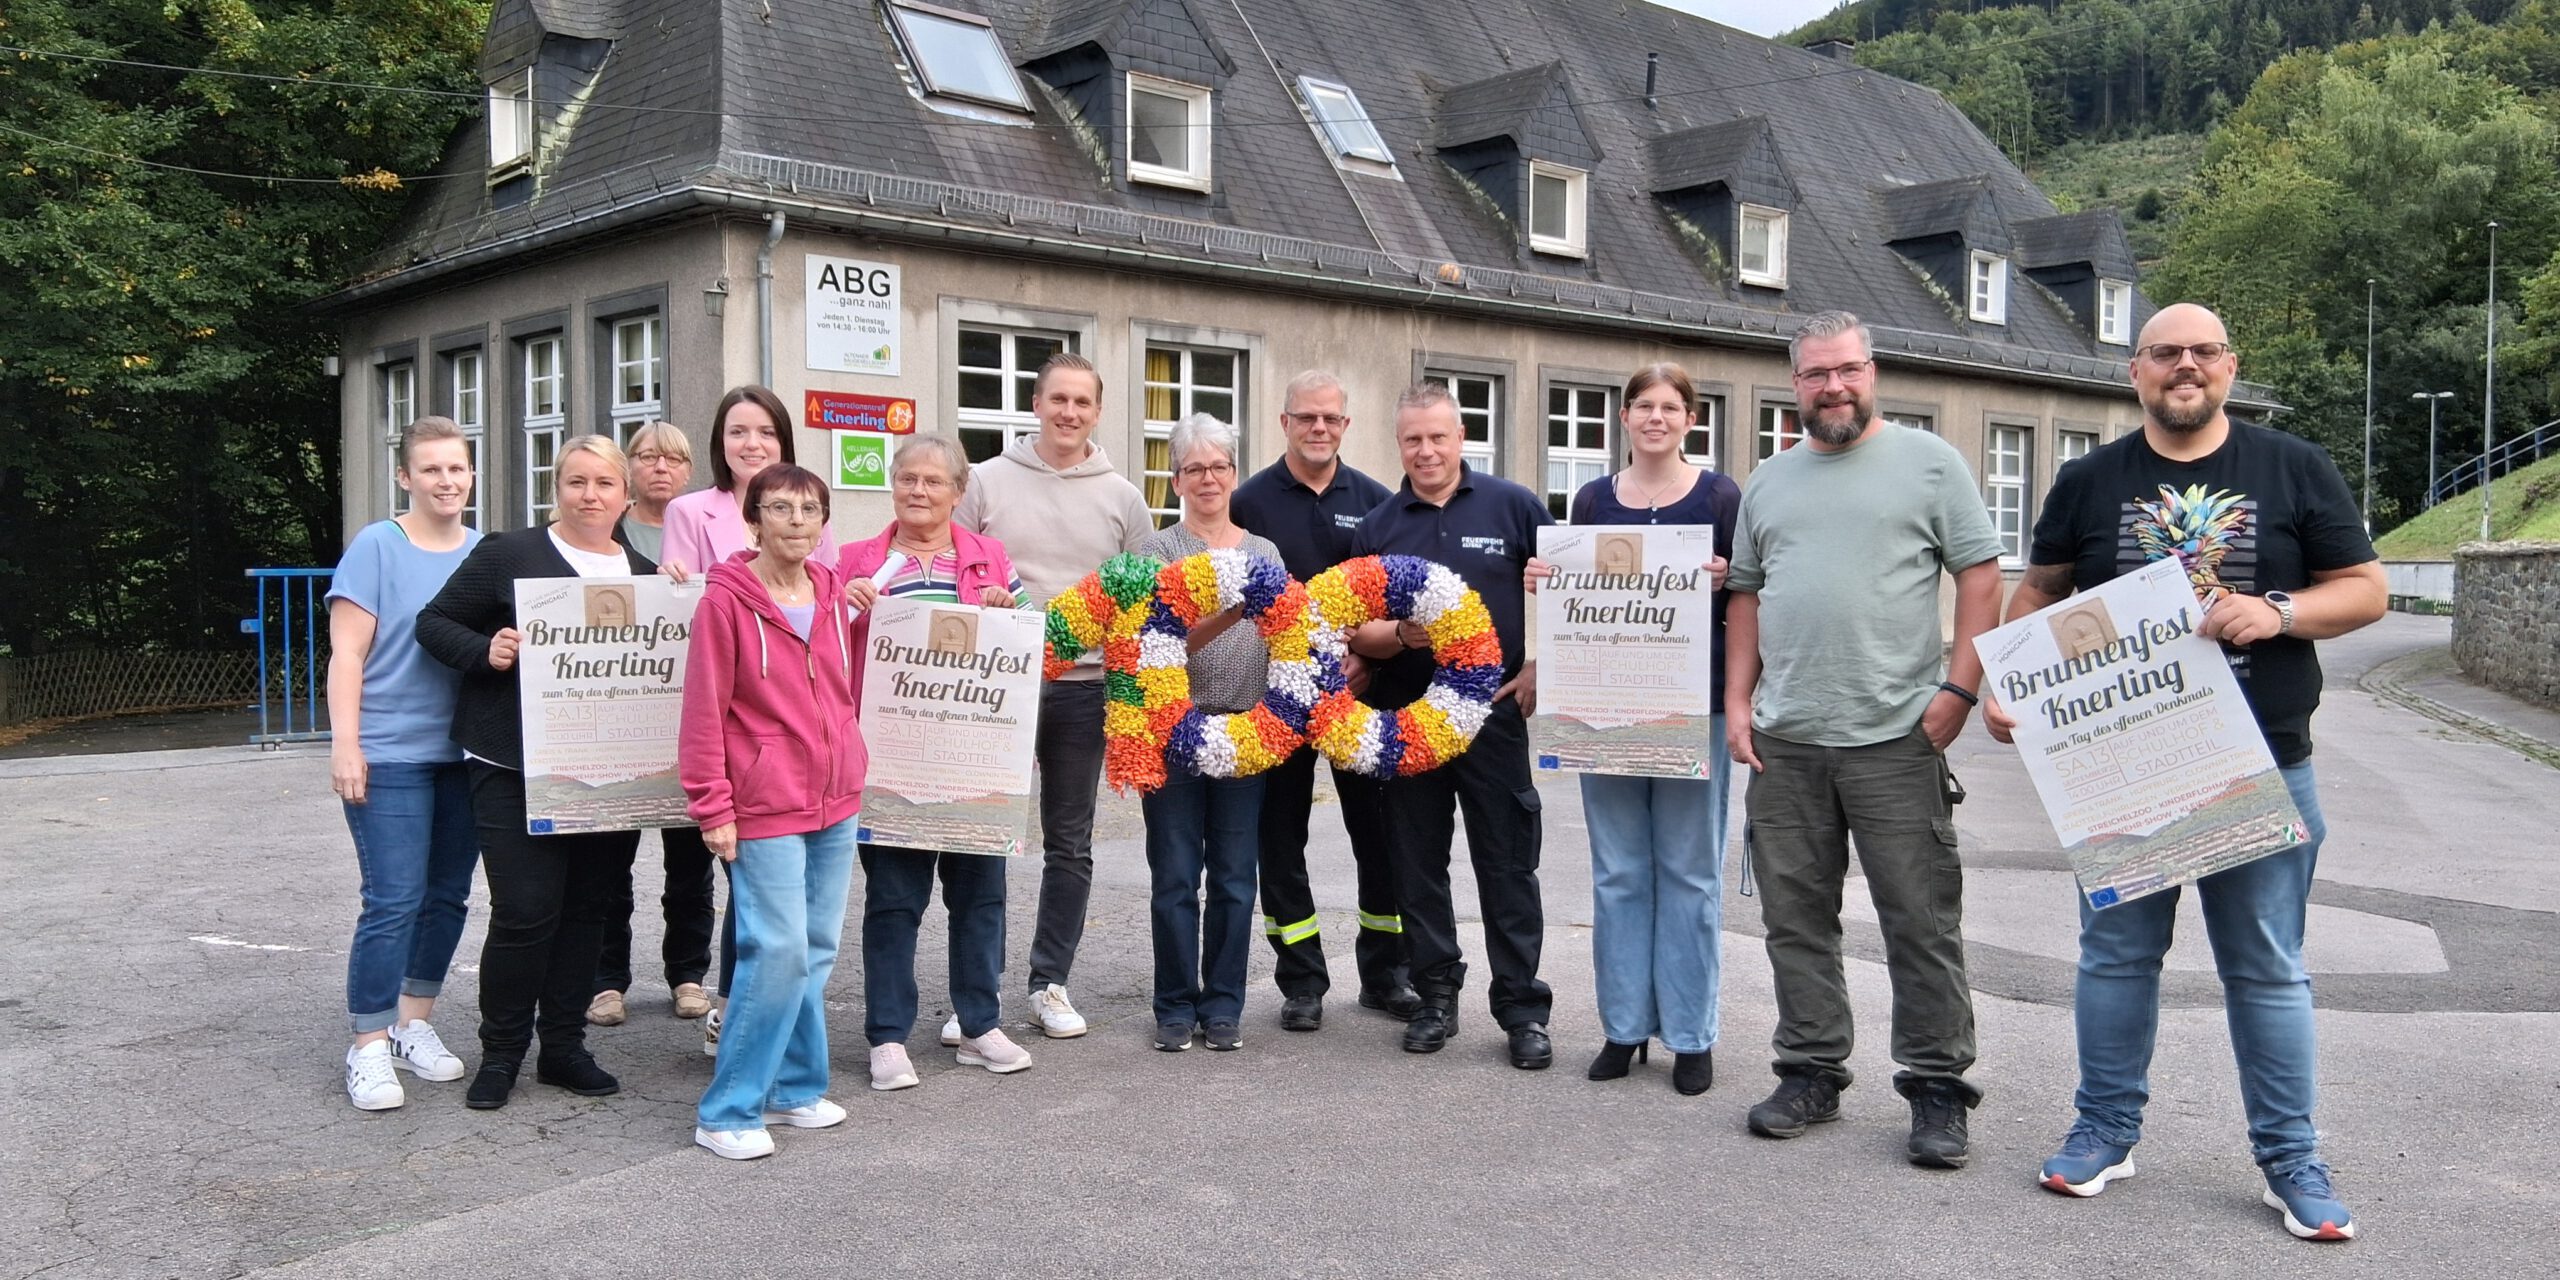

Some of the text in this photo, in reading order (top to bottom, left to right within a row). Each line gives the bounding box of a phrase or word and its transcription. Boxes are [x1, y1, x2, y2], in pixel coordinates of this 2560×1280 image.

[817, 263, 890, 297] ABG
[868, 299, 891, 310] nah!
[822, 312, 844, 321] Jeden
[854, 316, 885, 327] Dienstag
[823, 409, 886, 430] Knerling
[1334, 513, 1363, 523] FEUERW
[1461, 537, 1504, 545] FEUERWEHR
[1545, 564, 1700, 599] Brunnenfest
[1563, 597, 1676, 633] Knerling
[1553, 632, 1690, 644] zum Tag des offenen Denkmals
[1998, 631, 2032, 663] HONIGMUT
[873, 635, 1032, 679] Brunnenfest
[1556, 649, 1597, 664] SA.13
[1622, 650, 1643, 658] UND
[2000, 607, 2193, 703] Brunnenfest
[552, 651, 676, 684] Knerling
[1601, 659, 1675, 672] SCHULHOF
[1610, 673, 1677, 686] STADTTEIL
[541, 684, 683, 699] zum Tag des offenen Denkma
[891, 671, 1006, 713] Knerling
[2040, 659, 2185, 730] Knerling
[544, 705, 592, 721] SA.13
[878, 704, 1017, 724] zum Tag des offenen Denkmals
[1558, 705, 1608, 713] STREICHELZOO
[1614, 708, 1683, 717] KINDERFLOHMARKT
[878, 721, 922, 739] SA.13
[2043, 687, 2212, 755] zum Tag des offenen Denkmals
[2110, 705, 2219, 752] AUF UND UM DEM
[607, 725, 678, 739] STADTTEIL
[927, 725, 945, 735] AUF
[950, 727, 969, 737] UND
[926, 734, 999, 752] SCHULHOF
[2115, 716, 2225, 765] SCHULHOF &
[933, 749, 1001, 766] STADTTEIL
[2054, 745, 2111, 779] SA.13
[2134, 736, 2221, 778] STADTTEIL
[551, 764, 607, 772] STREICHELZOO
[551, 773, 622, 782] WEHR-SHOW
[877, 778, 929, 789] STREICHELZOO
[2094, 773, 2122, 790] UHR
[872, 786, 941, 799] WEHR-SHOW
[947, 792, 1008, 805] KLEIDER
[2087, 805, 2153, 834] STREICHELZOO
[2157, 772, 2247, 809] KINDERFLOHMARKT
